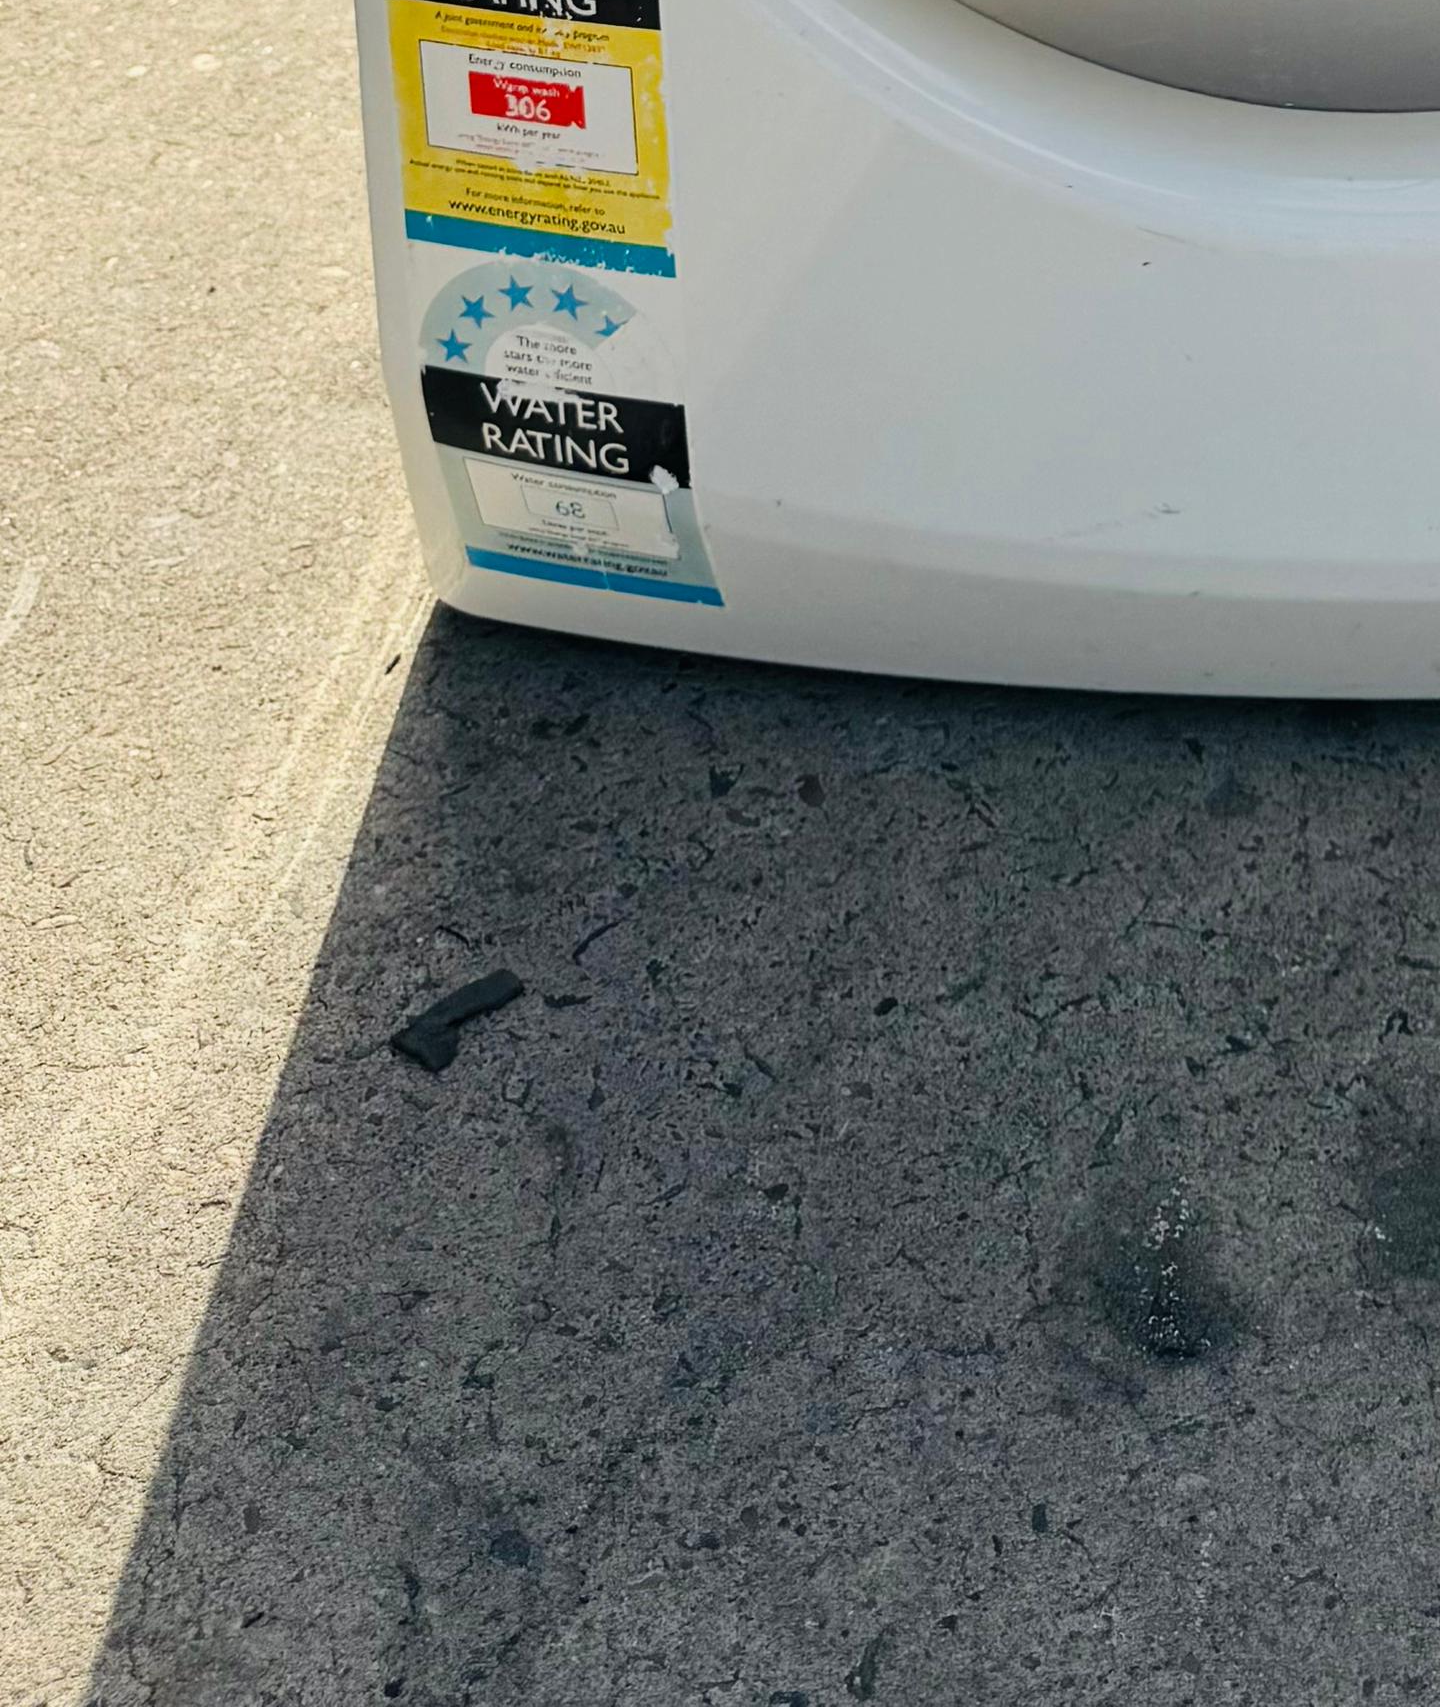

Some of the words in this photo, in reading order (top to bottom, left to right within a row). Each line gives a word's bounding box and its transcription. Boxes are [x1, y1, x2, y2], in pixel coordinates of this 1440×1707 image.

[505, 94, 551, 121] 306
[466, 187, 481, 197] For
[484, 191, 509, 202] more
[570, 204, 592, 214] refer
[595, 208, 606, 216] to
[449, 200, 626, 235] www.energyrating.gov.au
[504, 349, 533, 362] stars
[517, 336, 540, 349] The
[480, 382, 624, 433] WATER
[482, 422, 630, 473] RATING
